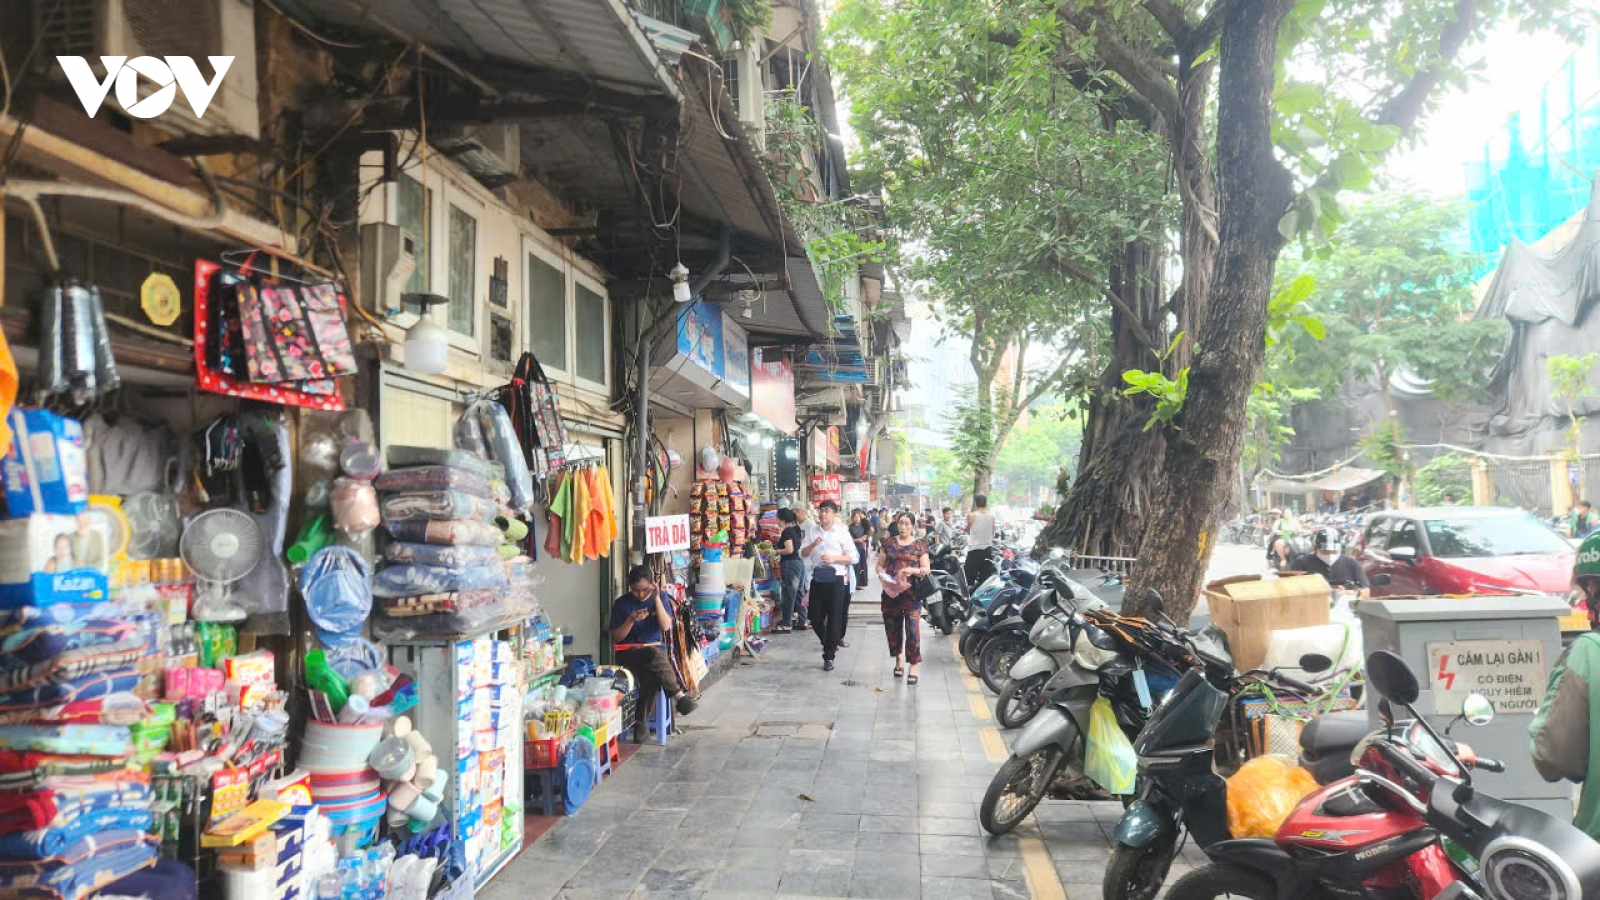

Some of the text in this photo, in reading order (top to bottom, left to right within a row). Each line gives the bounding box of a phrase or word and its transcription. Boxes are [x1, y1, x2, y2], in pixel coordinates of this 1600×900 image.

[648, 519, 687, 547] TRÀ ĐÁ
[1486, 652, 1504, 667] LẠI
[1478, 673, 1523, 686] CÓ ĐIỆN
[1500, 698, 1537, 709] NGƯỜI
